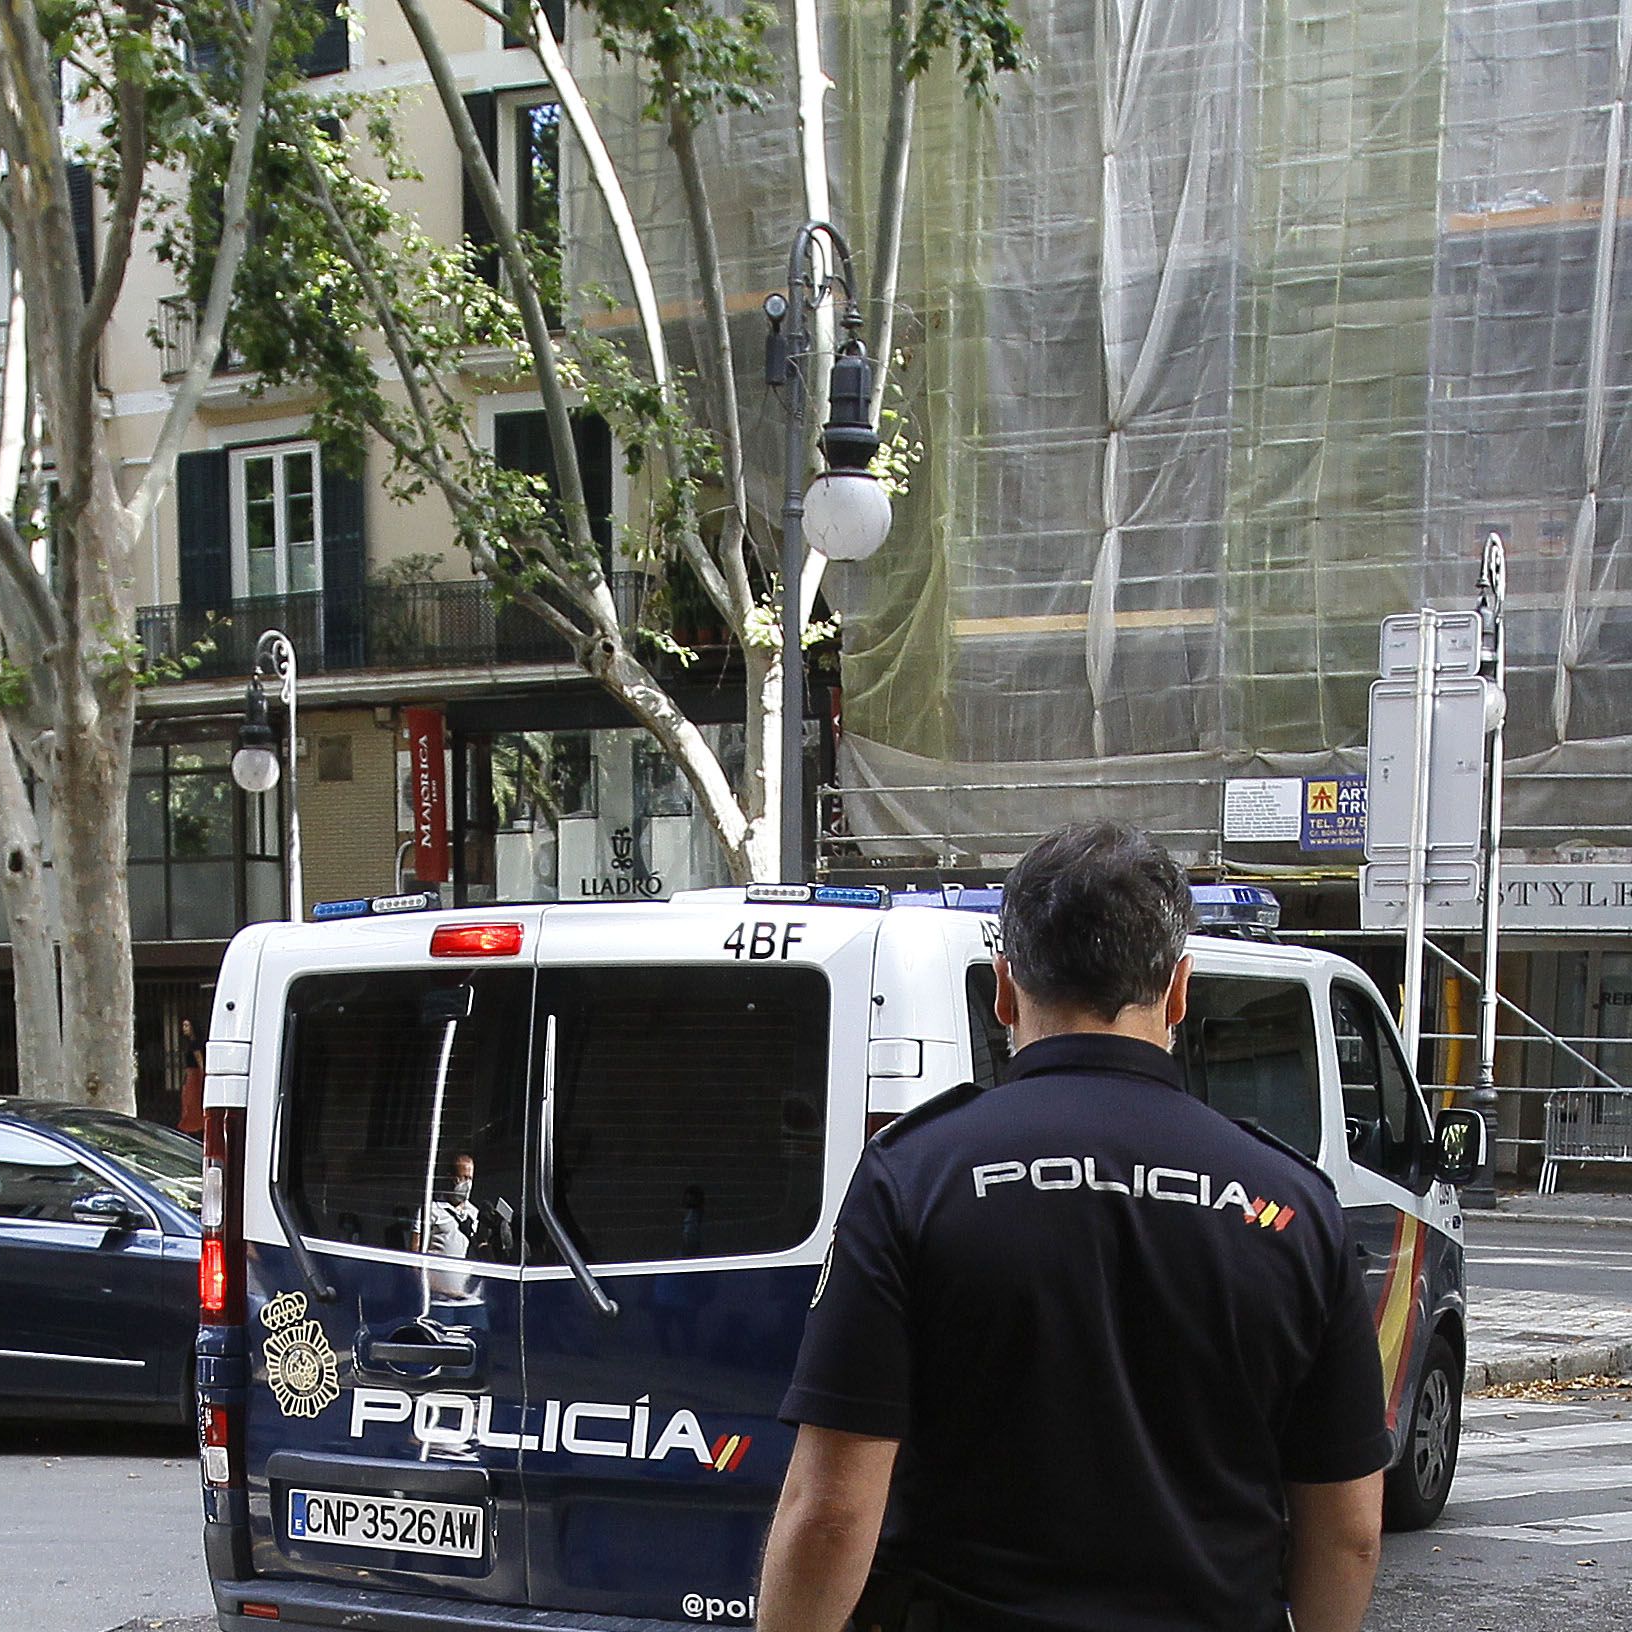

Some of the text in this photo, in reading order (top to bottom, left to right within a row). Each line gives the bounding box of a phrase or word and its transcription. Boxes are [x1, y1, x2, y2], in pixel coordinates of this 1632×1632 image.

[418, 734, 433, 848] MAJORICA
[1309, 818, 1334, 829] TEL.
[1337, 816, 1356, 828] 971
[581, 871, 662, 898] LLADRÓ
[722, 921, 808, 961] 4BF
[972, 1156, 1258, 1218] POLICIA
[349, 1386, 714, 1465] POLICÍA
